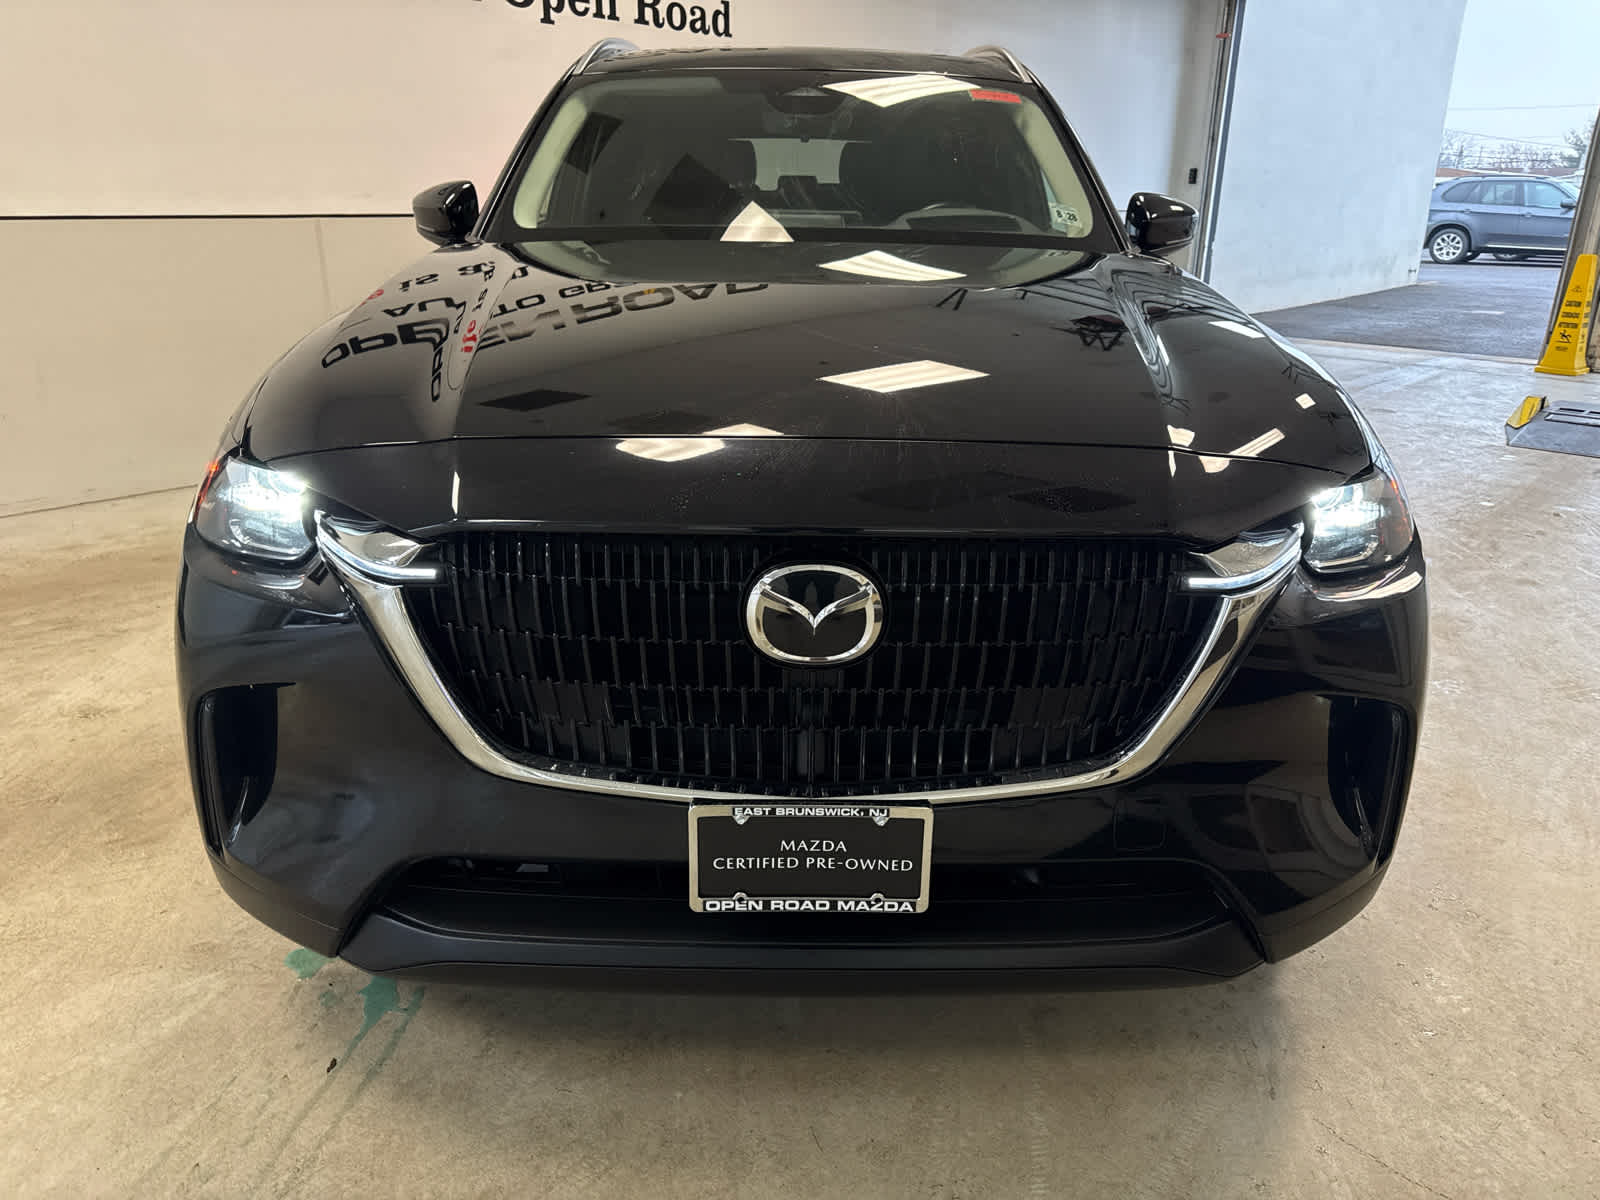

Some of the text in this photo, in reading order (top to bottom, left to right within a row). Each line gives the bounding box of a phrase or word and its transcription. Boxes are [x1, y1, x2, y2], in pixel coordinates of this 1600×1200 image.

[505, 0, 733, 38] pen Road
[733, 807, 888, 818] EAST BRUNSWICK, NJ
[780, 839, 848, 853] MAZDA
[712, 857, 914, 872] CERTIFIED PRE-OWNED
[705, 900, 914, 912] OPEN ROAD MAZDA
